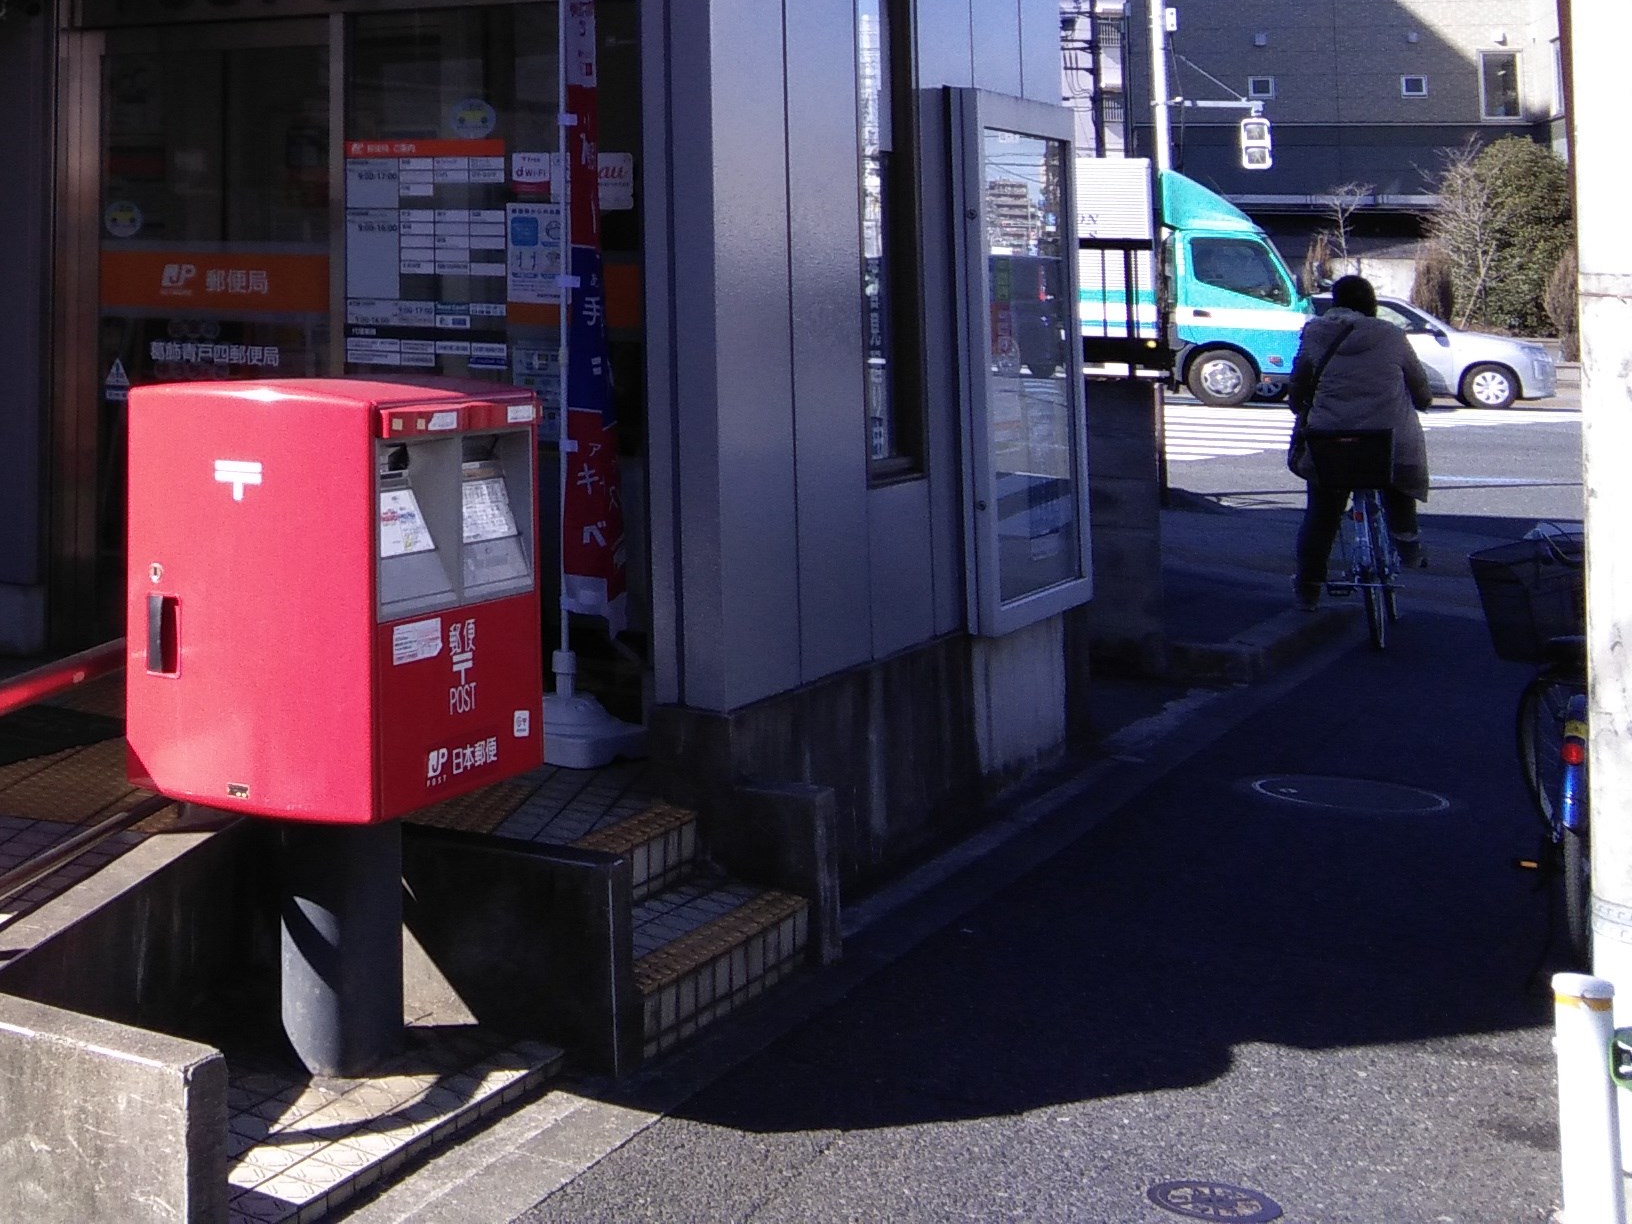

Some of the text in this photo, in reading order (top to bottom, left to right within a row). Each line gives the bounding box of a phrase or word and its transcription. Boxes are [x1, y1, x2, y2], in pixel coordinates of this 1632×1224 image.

[205, 269, 268, 294] 郵便局
[150, 339, 280, 366] 葛飾青戸四郵便局
[449, 618, 477, 656] 郵便
[449, 682, 477, 716] POST
[452, 736, 498, 776] 日本郵便
